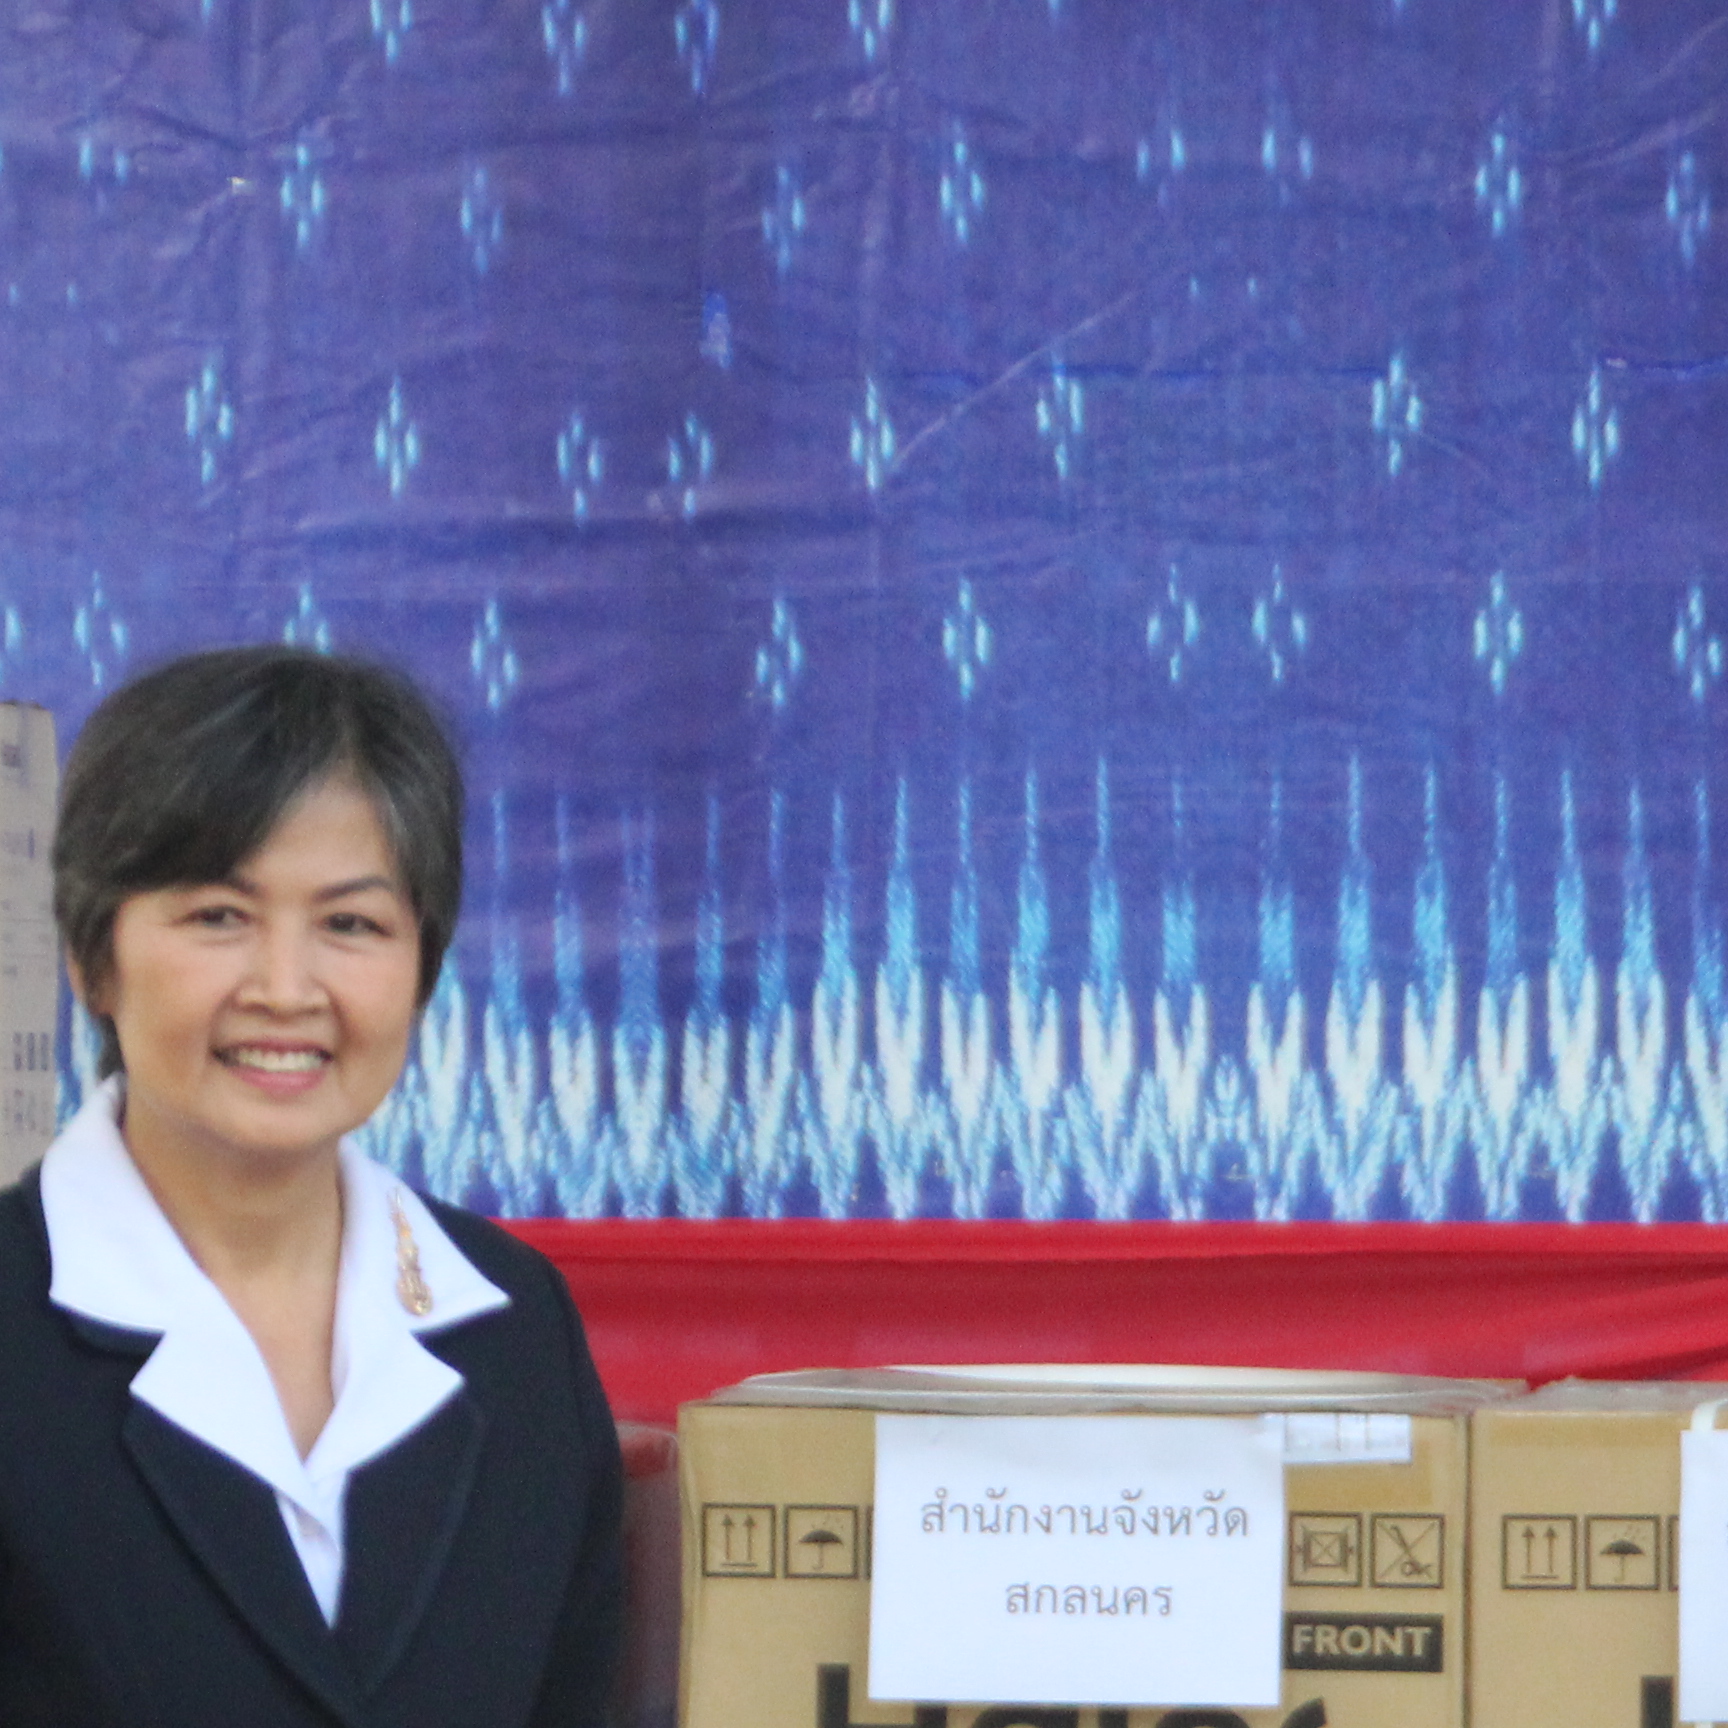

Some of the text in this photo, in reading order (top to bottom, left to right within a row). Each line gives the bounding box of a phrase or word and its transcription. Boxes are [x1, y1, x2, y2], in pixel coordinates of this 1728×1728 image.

[921, 1486, 1249, 1537] สำนักงานจังหวัด
[1005, 1582, 1173, 1616] สกลนคร
[1292, 1624, 1433, 1658] FRONT
